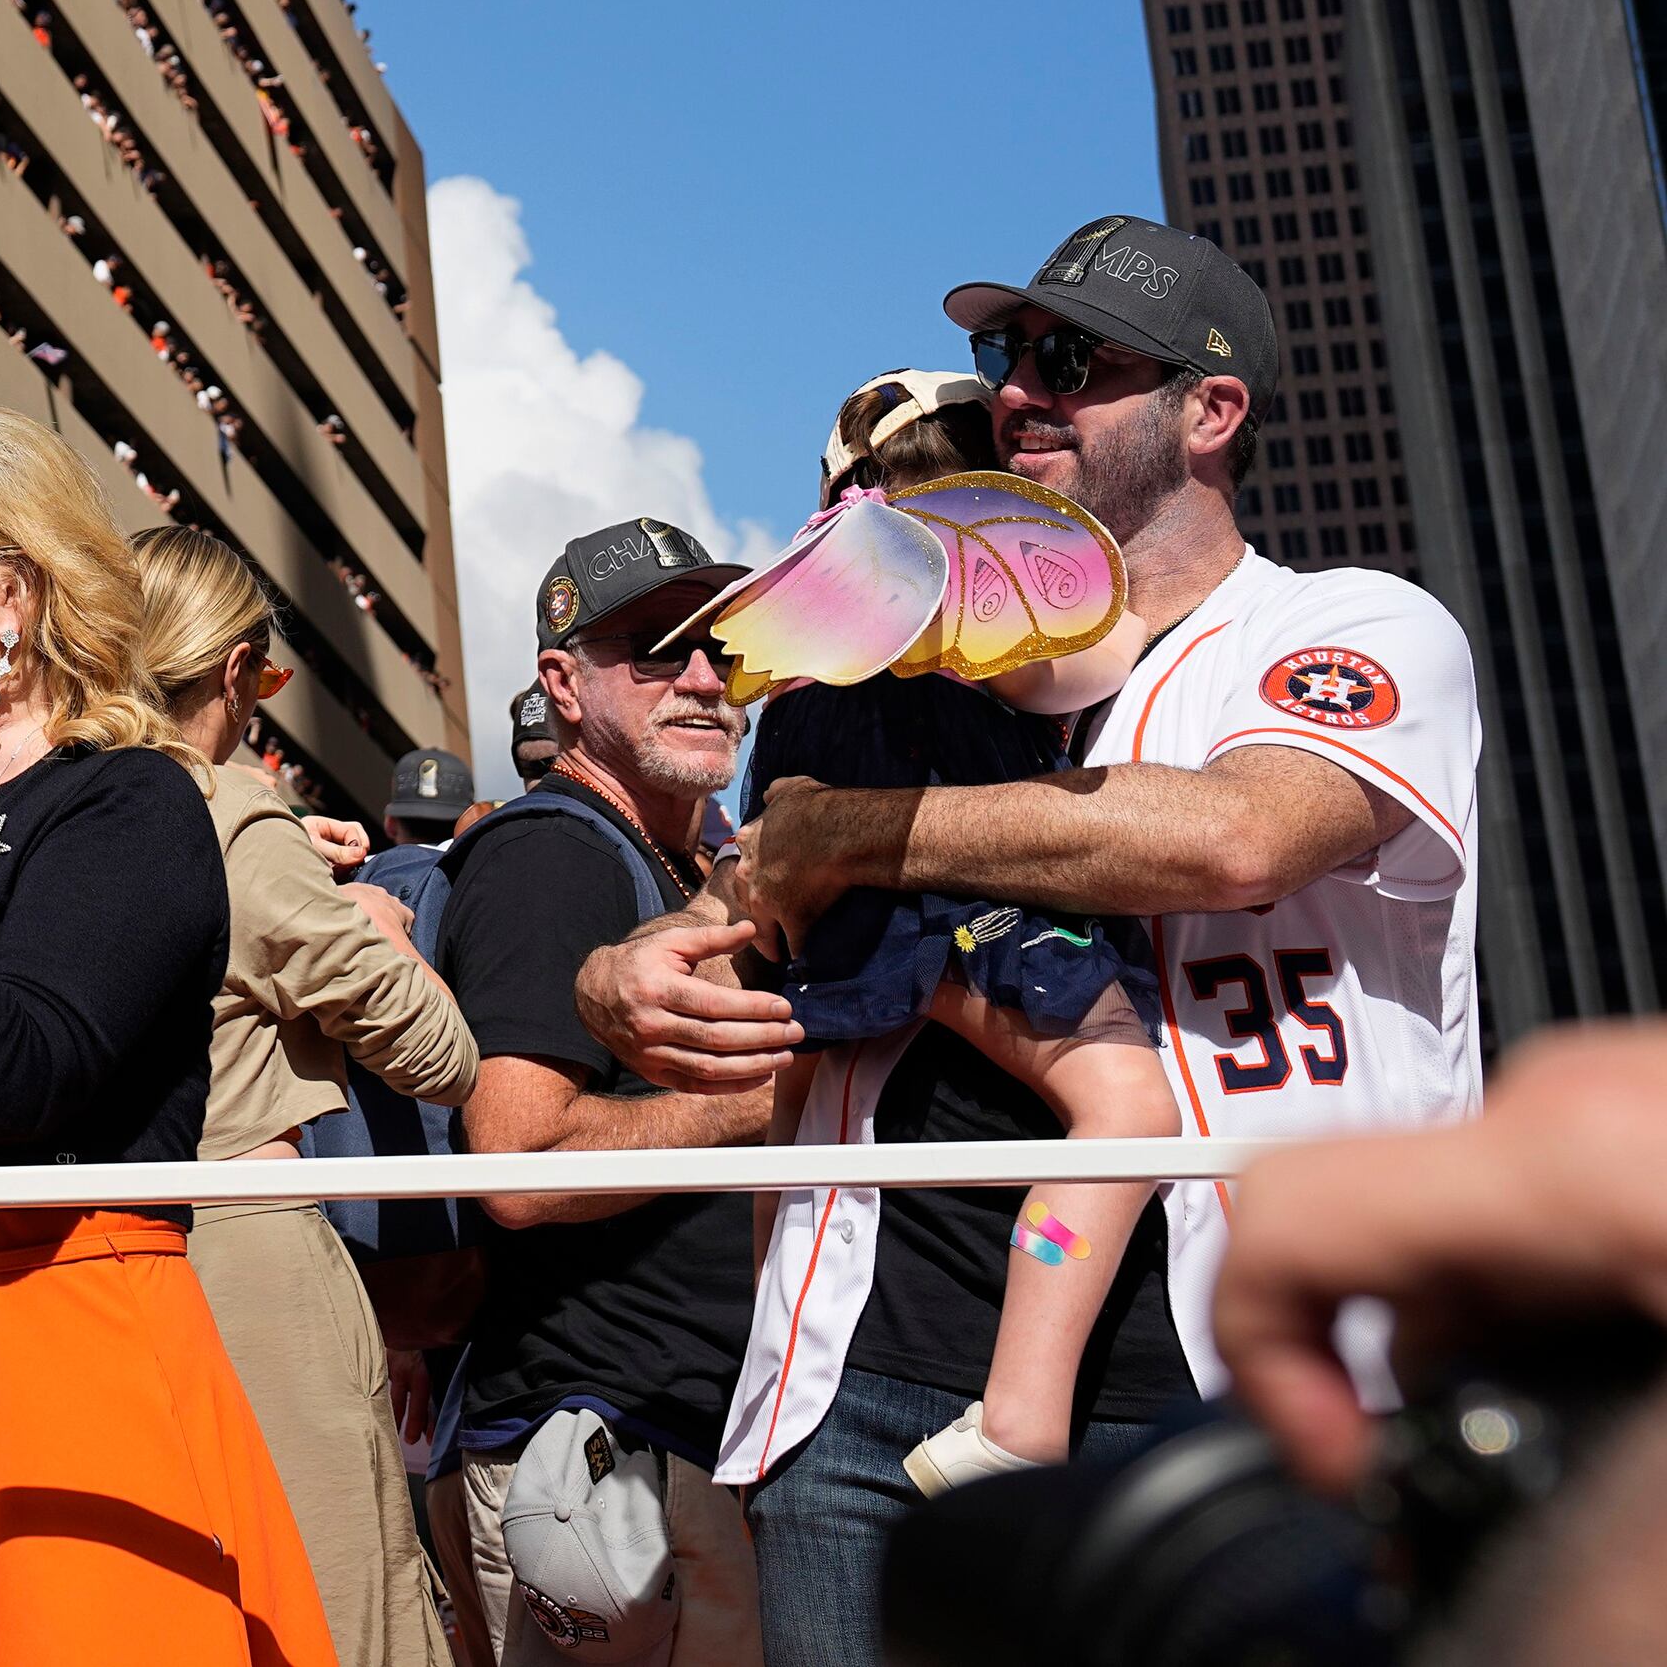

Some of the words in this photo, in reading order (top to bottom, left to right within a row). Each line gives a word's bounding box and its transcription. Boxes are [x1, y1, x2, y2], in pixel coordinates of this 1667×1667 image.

[1094, 243, 1180, 300] MPS
[1282, 650, 1387, 685] HOUSTON
[1276, 698, 1372, 725] ASTROS
[1181, 947, 1349, 1096] 35
